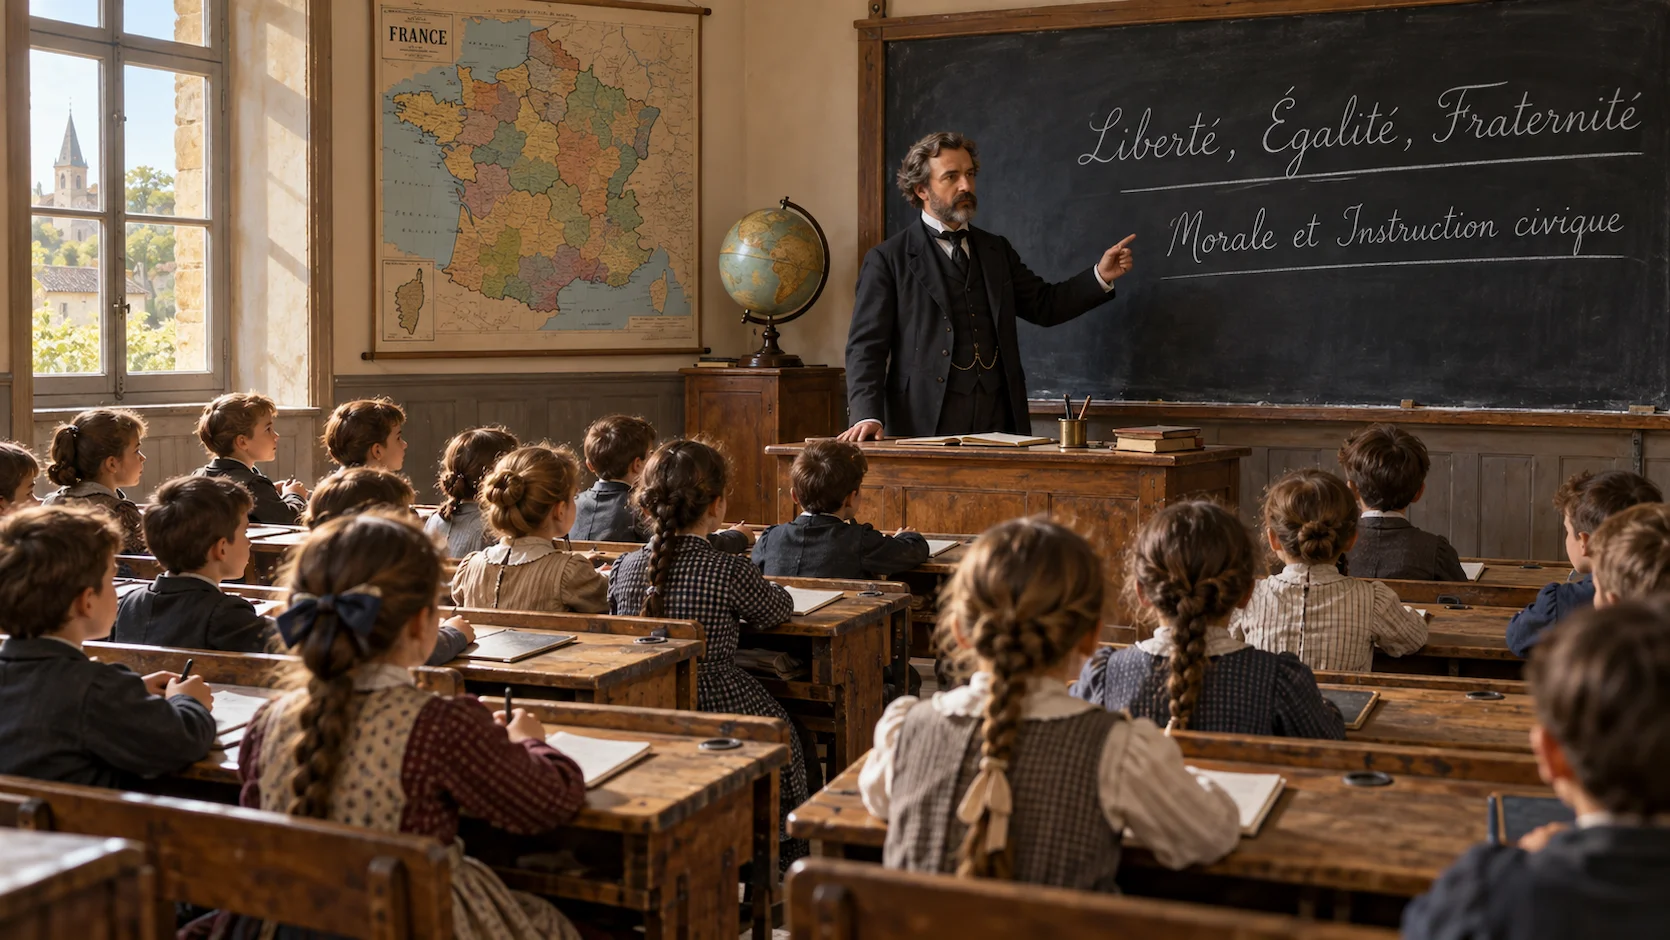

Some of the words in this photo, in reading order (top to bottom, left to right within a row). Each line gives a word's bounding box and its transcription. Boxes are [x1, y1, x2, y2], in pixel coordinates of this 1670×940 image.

[389, 25, 448, 46] FRANCE
[1077, 107, 1236, 164] Liberté,
[1262, 85, 1414, 179] Égalité,
[1432, 80, 1643, 144] Fraternité
[1166, 206, 1278, 264] Morale
[1292, 213, 1319, 248] et
[1336, 203, 1498, 248] Instruction
[1514, 206, 1625, 257] civique
